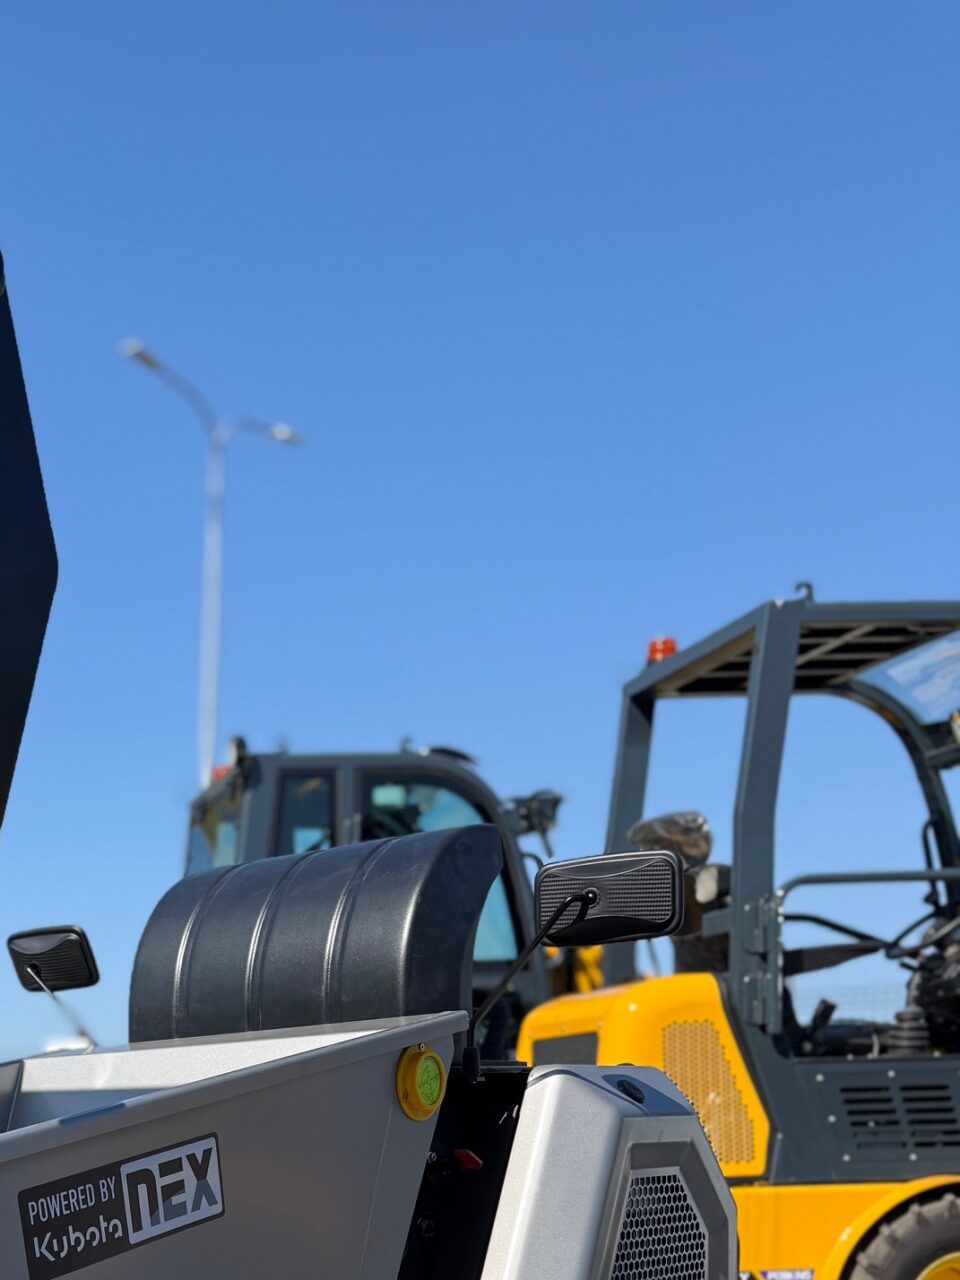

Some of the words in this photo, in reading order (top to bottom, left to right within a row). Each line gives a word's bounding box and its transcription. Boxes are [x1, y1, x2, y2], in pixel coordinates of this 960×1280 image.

[28, 1183, 96, 1226] POWERED
[99, 1176, 116, 1207] BY
[33, 1214, 123, 1262] Kubota
